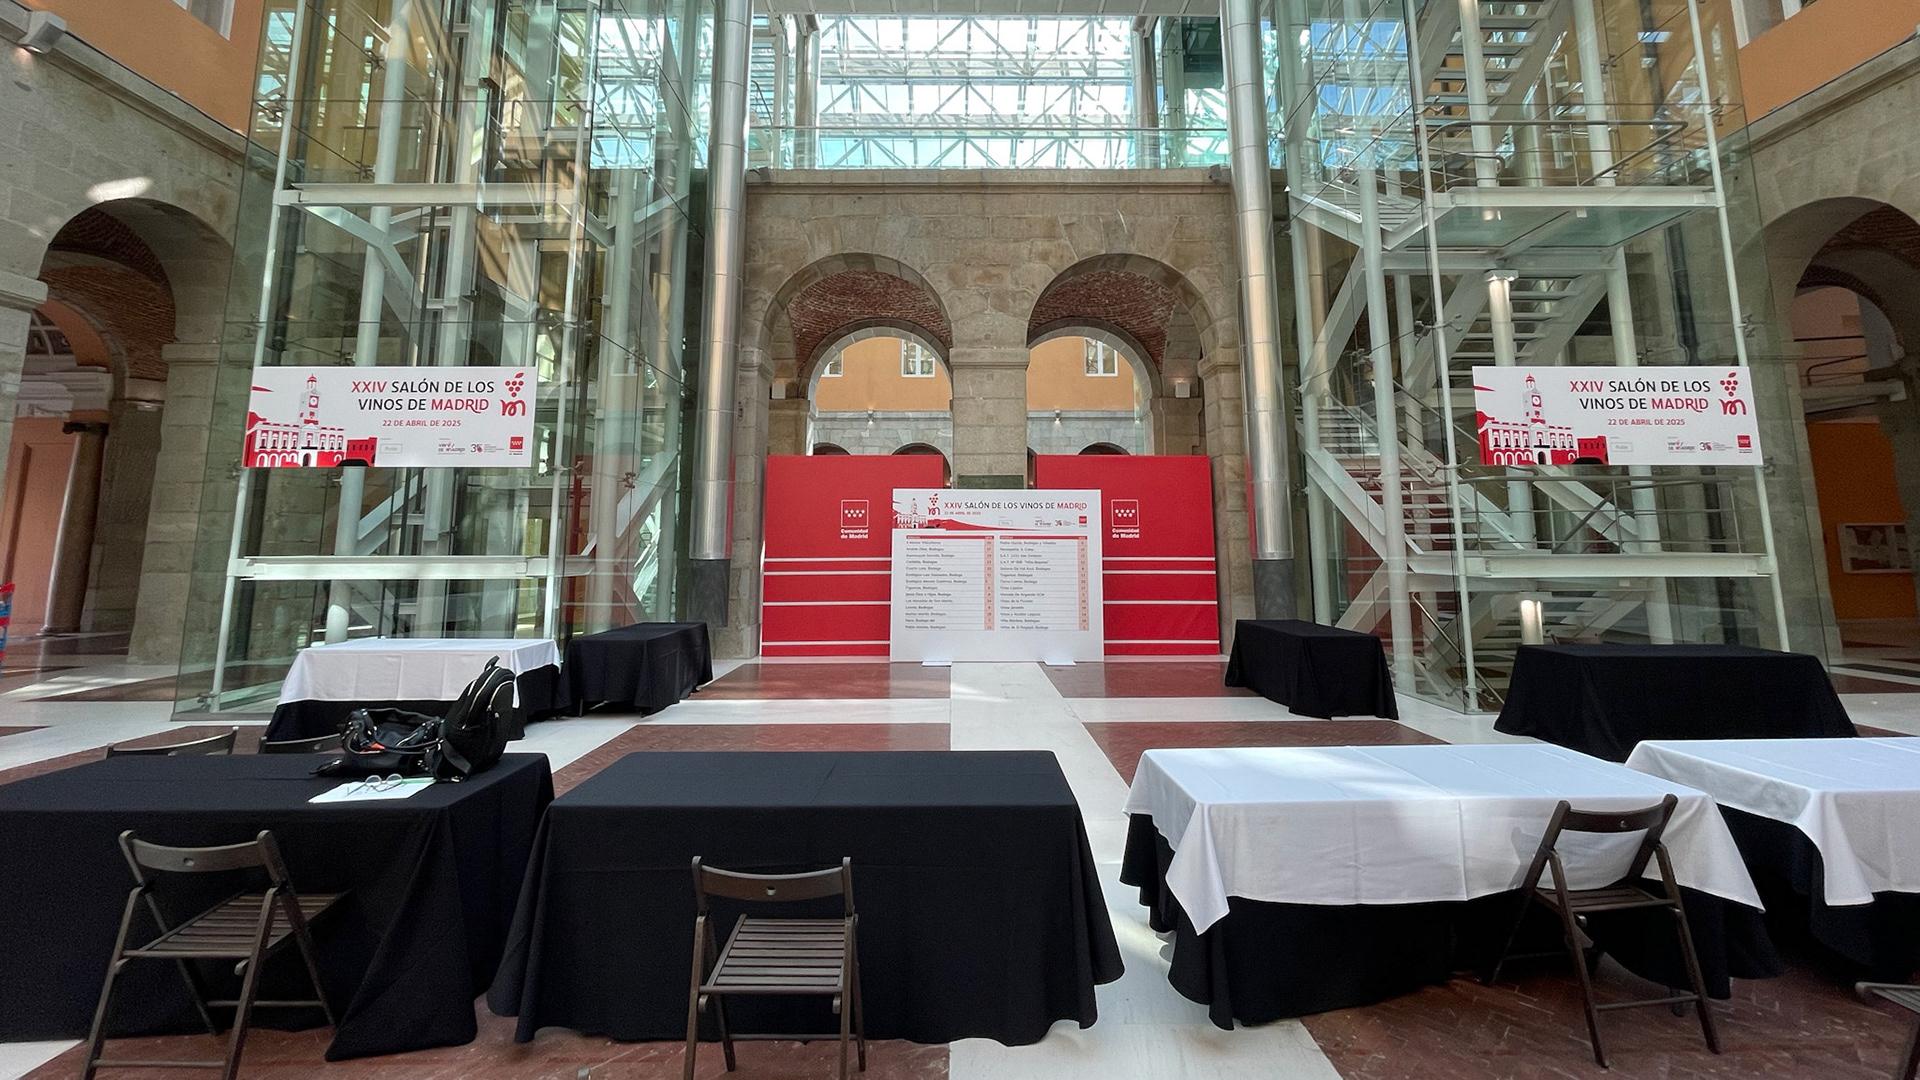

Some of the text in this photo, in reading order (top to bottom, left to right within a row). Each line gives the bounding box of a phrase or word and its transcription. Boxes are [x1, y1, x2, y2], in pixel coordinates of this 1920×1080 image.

[351, 378, 494, 392] XXIV SALÓN DE LOS
[1570, 378, 1710, 392] XXIV SALÓN DE LOS
[359, 399, 489, 414] VINOS DE MADRID
[1580, 398, 1709, 412] VINOS DE MADRID
[965, 501, 989, 509] SALÓN
[1057, 503, 1087, 511] MADRID
